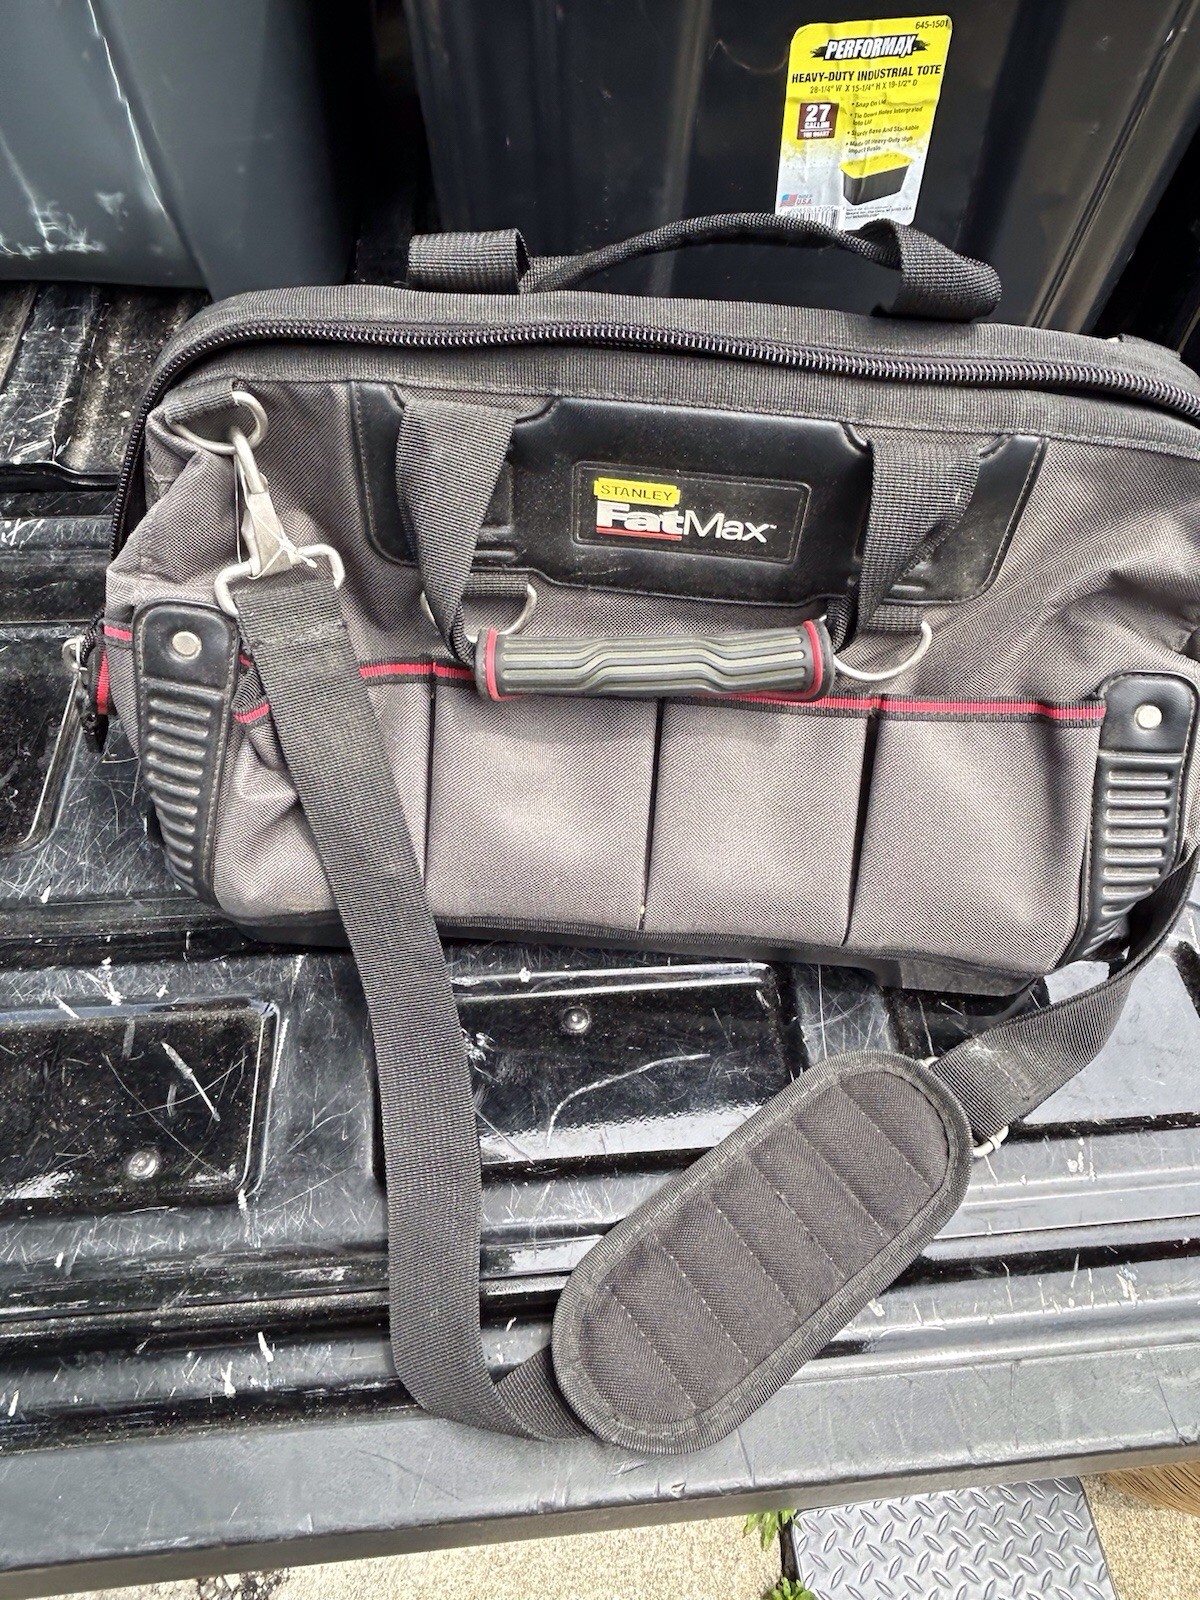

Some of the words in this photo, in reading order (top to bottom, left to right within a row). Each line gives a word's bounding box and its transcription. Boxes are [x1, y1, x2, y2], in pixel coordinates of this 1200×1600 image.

[824, 34, 917, 60] PERFORMAX
[792, 70, 855, 83] HEAVY-DUTY
[857, 66, 914, 81] INDUSTRIAL
[917, 64, 942, 76] TOTE
[835, 84, 843, 92] W
[805, 104, 832, 122] 27
[600, 483, 673, 502] STANLEY
